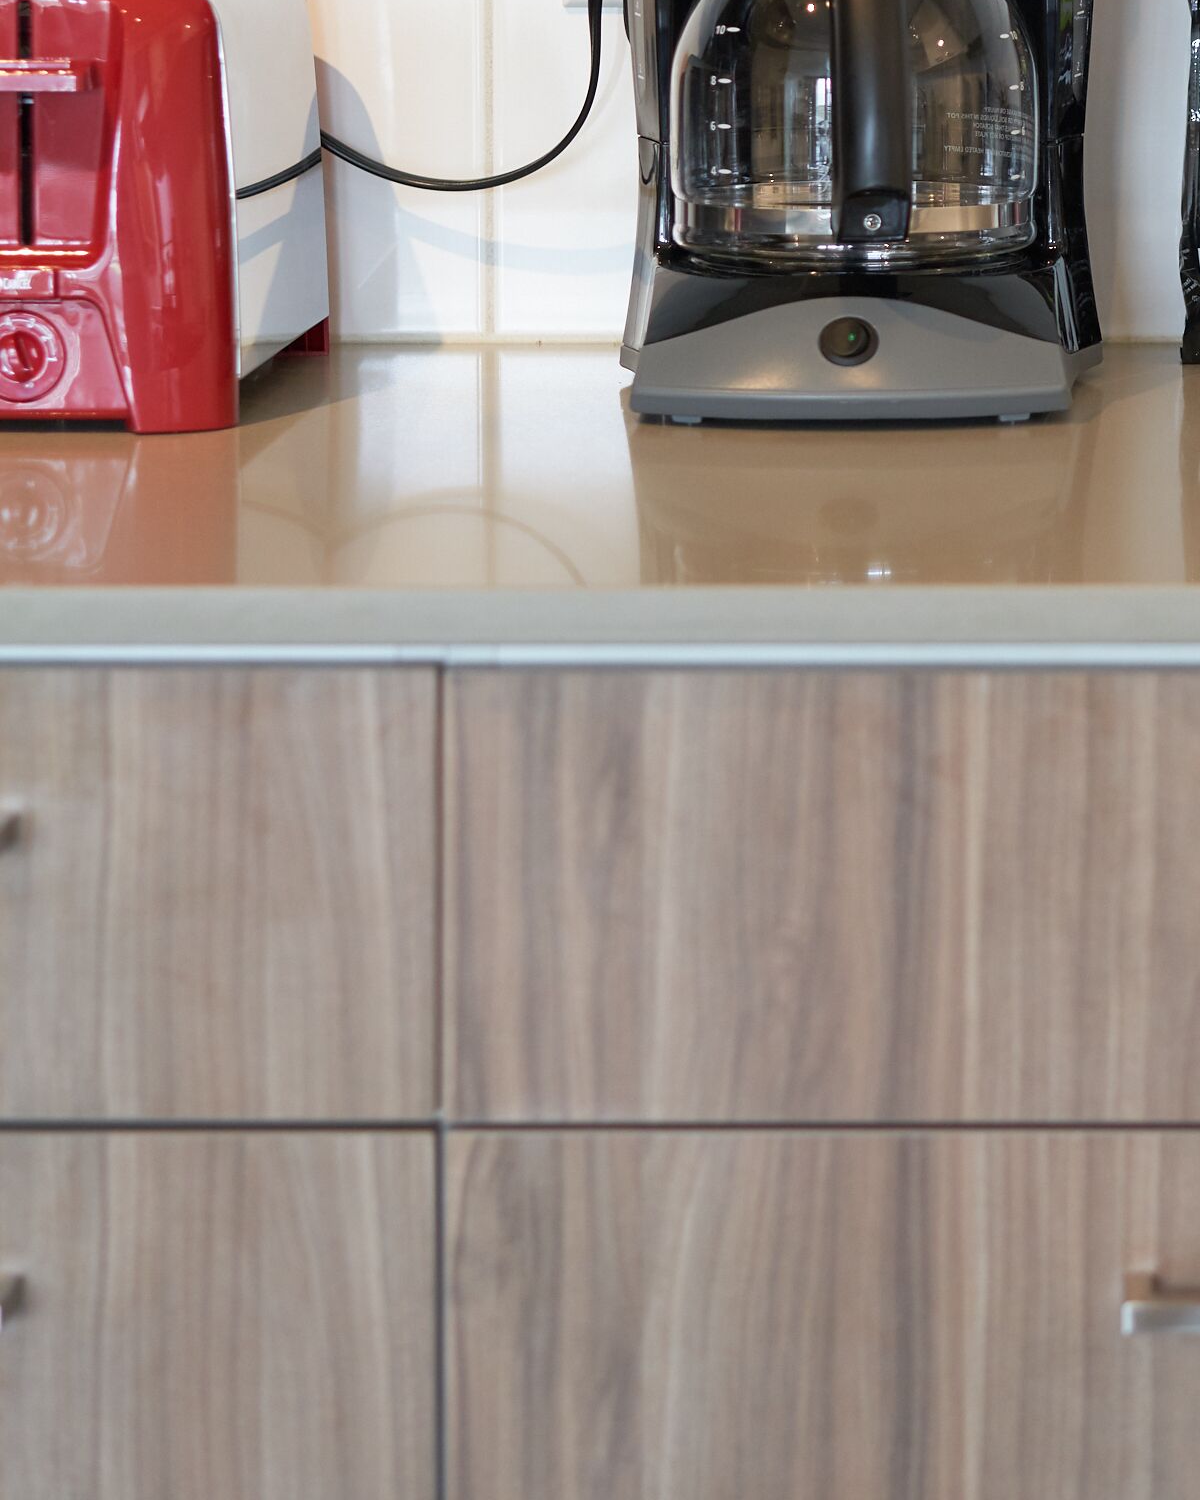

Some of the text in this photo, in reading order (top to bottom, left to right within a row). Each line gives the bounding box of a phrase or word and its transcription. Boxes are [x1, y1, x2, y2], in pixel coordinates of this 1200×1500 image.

[716, 24, 726, 34] 10
[710, 75, 717, 86] 8
[710, 121, 716, 131] 6
[710, 166, 718, 176] 4
